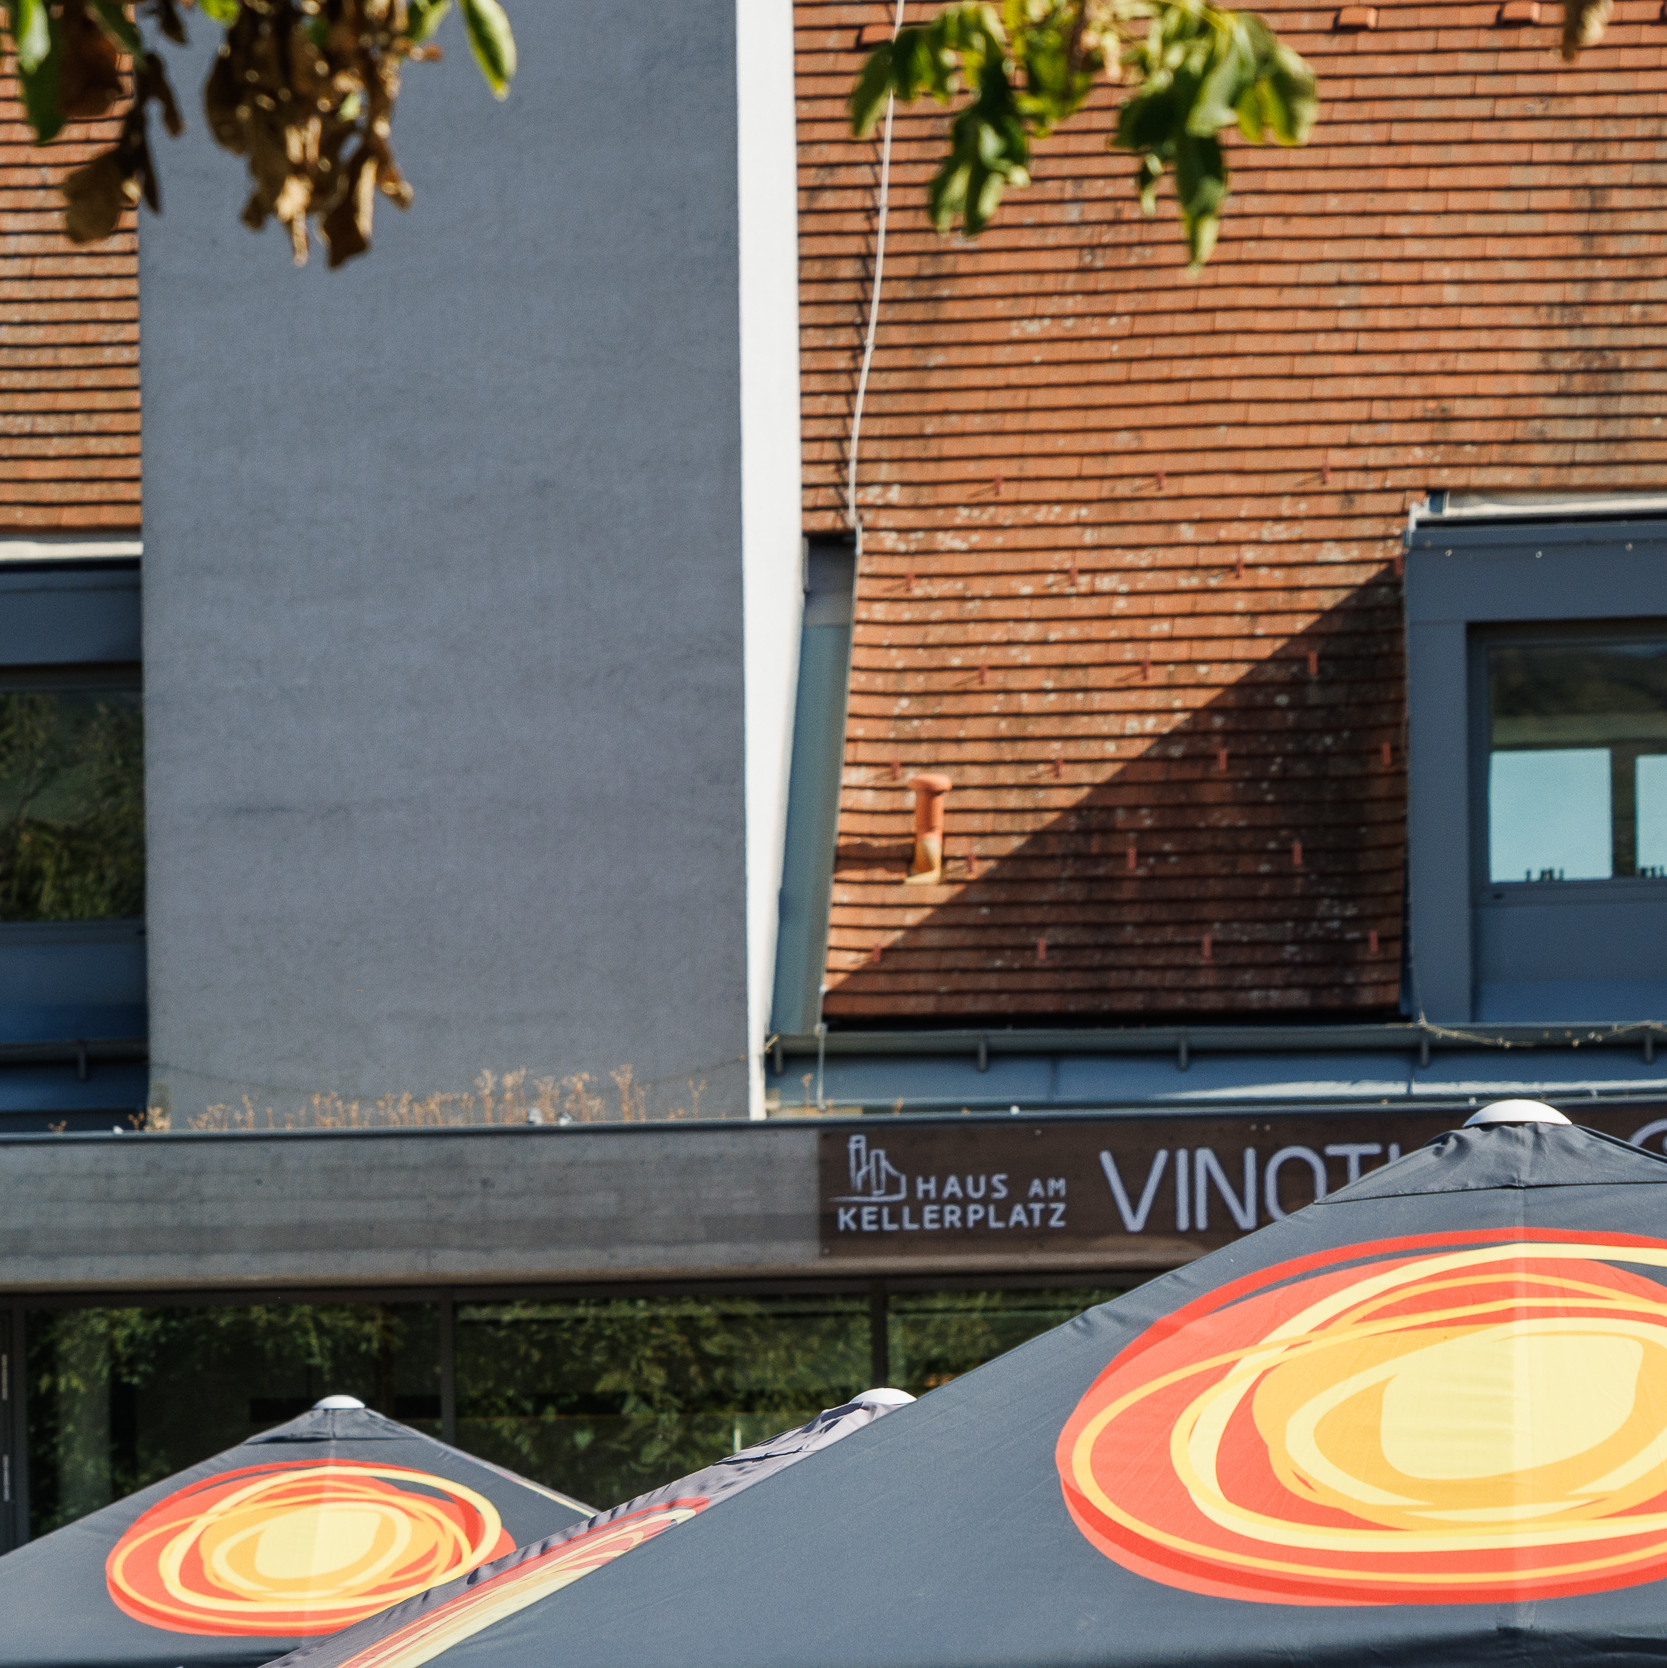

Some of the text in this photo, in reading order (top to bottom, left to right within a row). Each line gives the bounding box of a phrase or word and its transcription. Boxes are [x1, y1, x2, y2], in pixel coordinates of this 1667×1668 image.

[916, 1173, 1067, 1200] HAUS AM
[837, 1202, 1067, 1232] KELLERPLATZ
